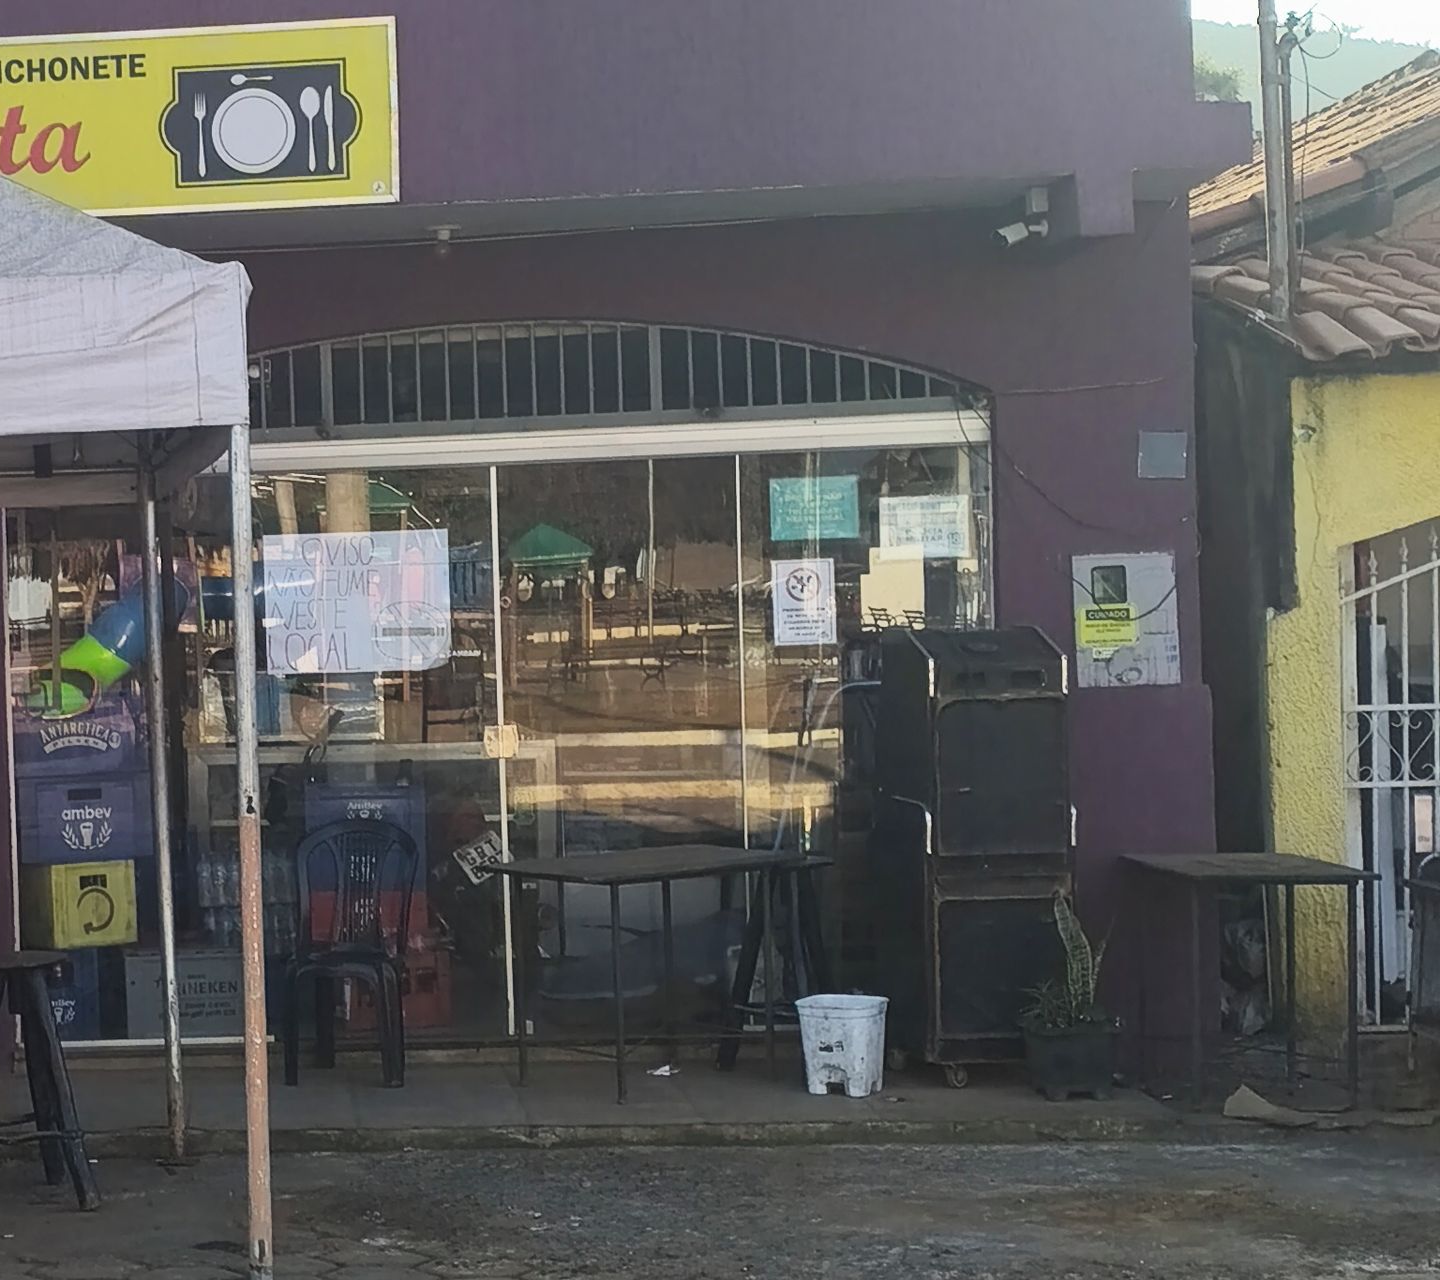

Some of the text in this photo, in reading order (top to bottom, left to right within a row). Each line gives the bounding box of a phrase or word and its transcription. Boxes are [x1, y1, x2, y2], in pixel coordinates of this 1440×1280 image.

[268, 567, 379, 598] NÃO FUME
[268, 598, 348, 631] NESTE
[268, 632, 361, 671] LOCAL
[40, 721, 110, 744] ANTARCTICA
[61, 805, 112, 820] ambev
[178, 980, 239, 995] INEKEN
